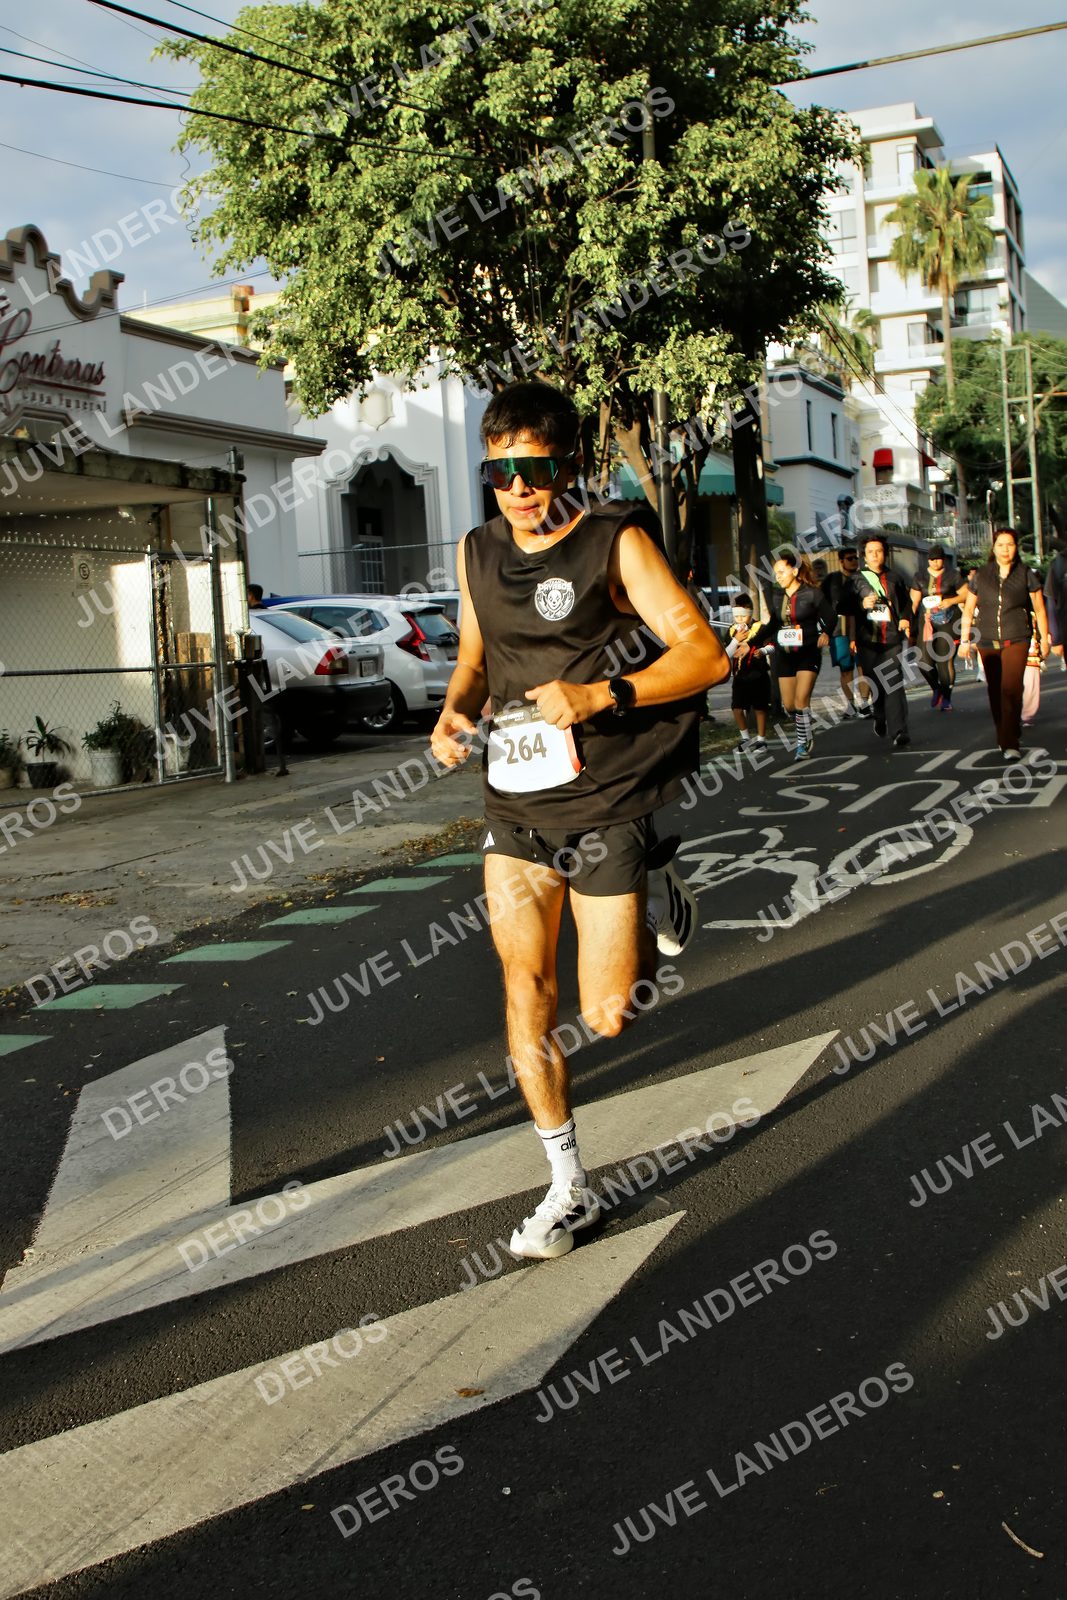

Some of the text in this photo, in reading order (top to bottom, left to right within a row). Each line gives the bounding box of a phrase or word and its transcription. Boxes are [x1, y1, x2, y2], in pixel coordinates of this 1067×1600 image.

[784, 631, 797, 639] 669
[503, 732, 547, 765] 264
[769, 747, 1067, 779] OLO
[738, 774, 1067, 817] BUS
[560, 1137, 577, 1151] alo
